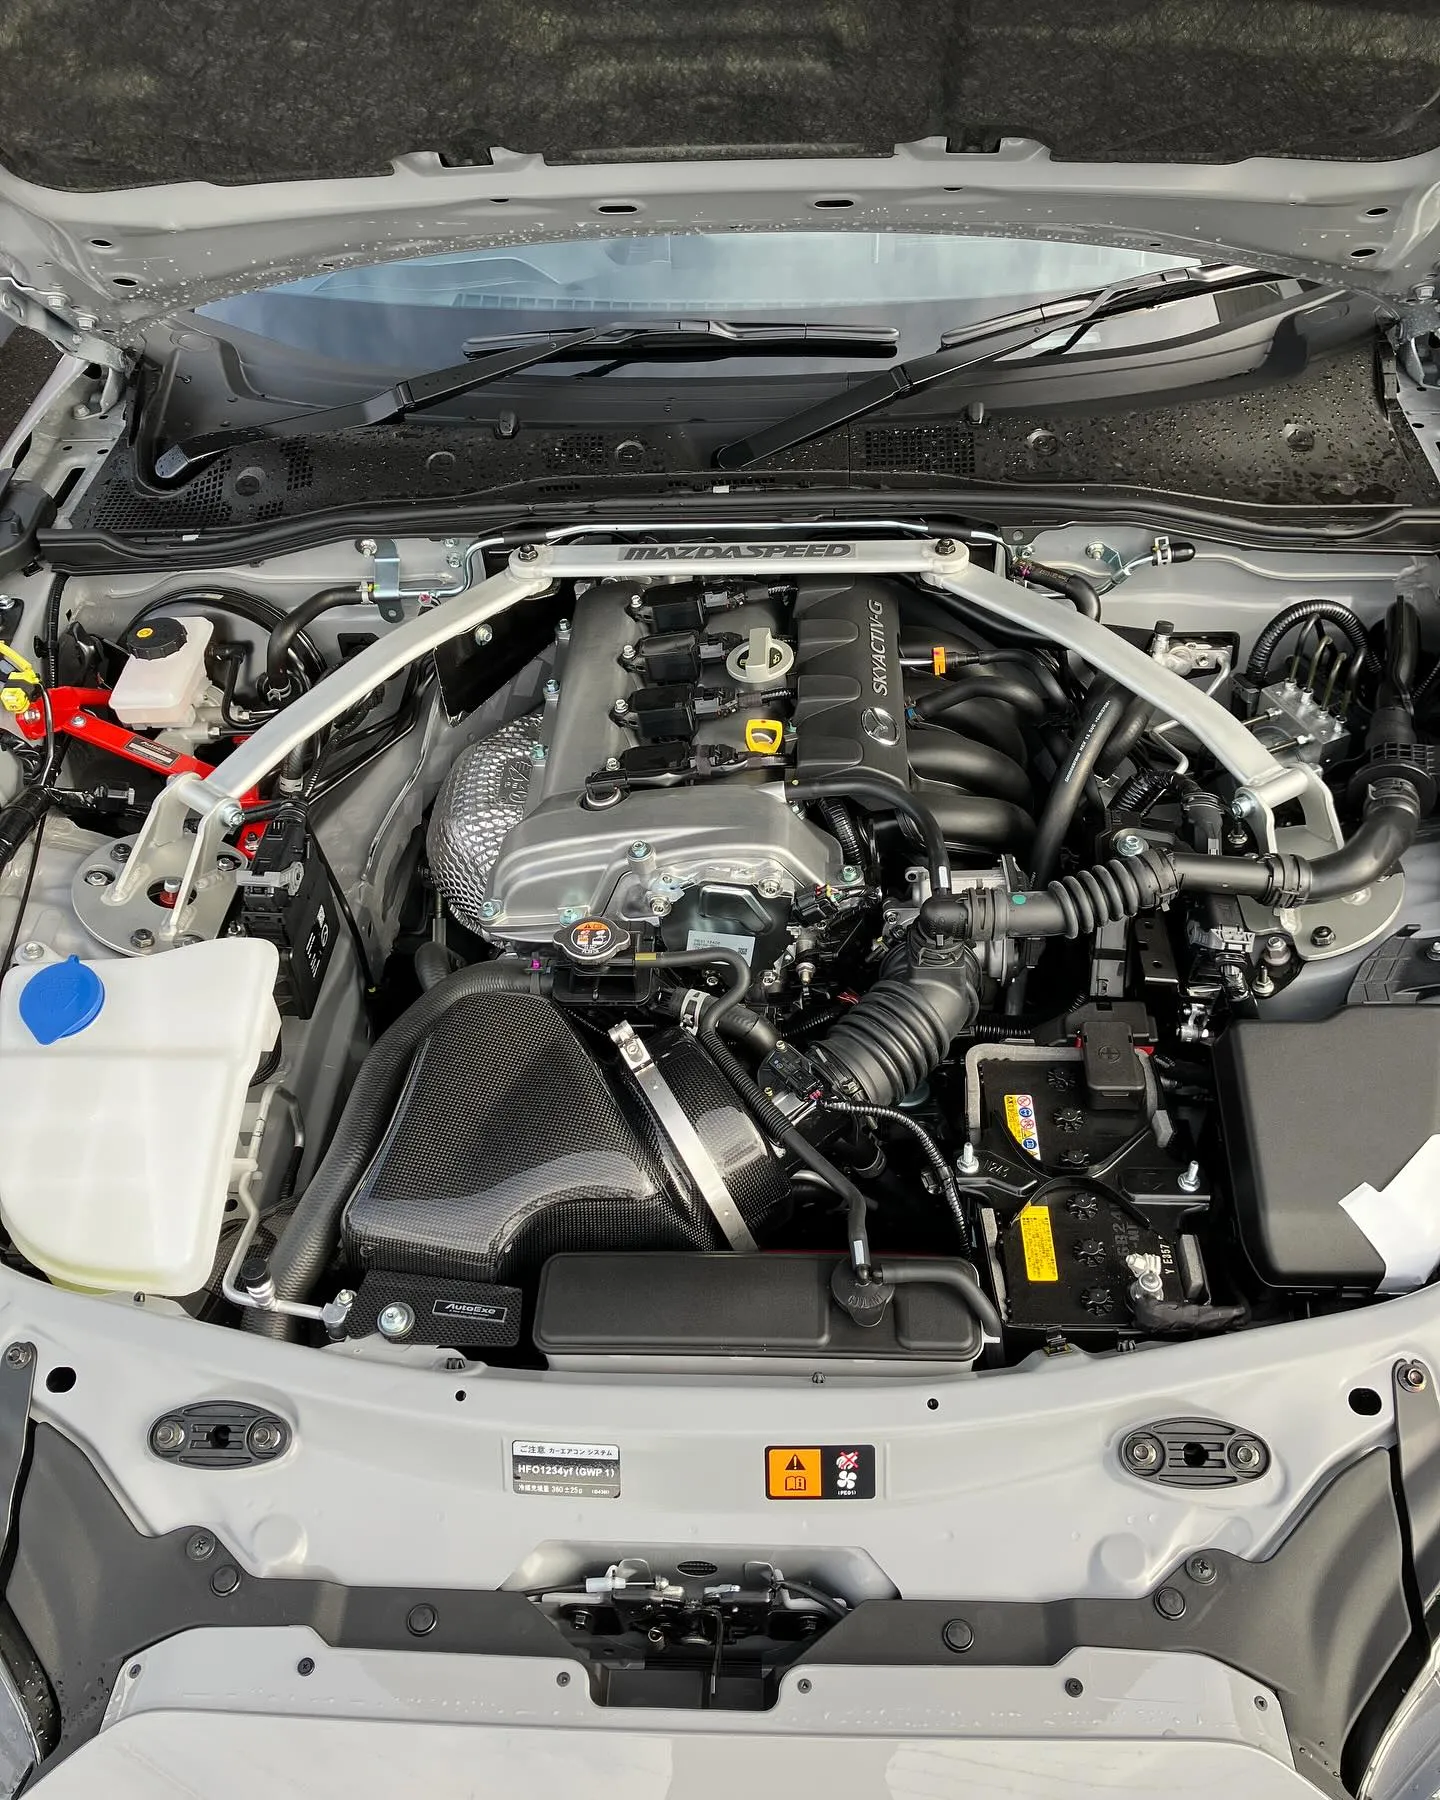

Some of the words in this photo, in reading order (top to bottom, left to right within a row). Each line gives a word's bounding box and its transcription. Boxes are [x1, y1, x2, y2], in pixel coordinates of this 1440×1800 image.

[624, 543, 851, 561] MAZDASPEED
[867, 599, 888, 697] SKYACTIV-G
[1159, 1243, 1175, 1266] E357
[444, 1303, 497, 1315] AutoExe
[587, 1448, 613, 1456] システム
[517, 1464, 574, 1478] HFO1234yf
[575, 1467, 603, 1477] (GWP
[604, 1468, 615, 1478] 1)
